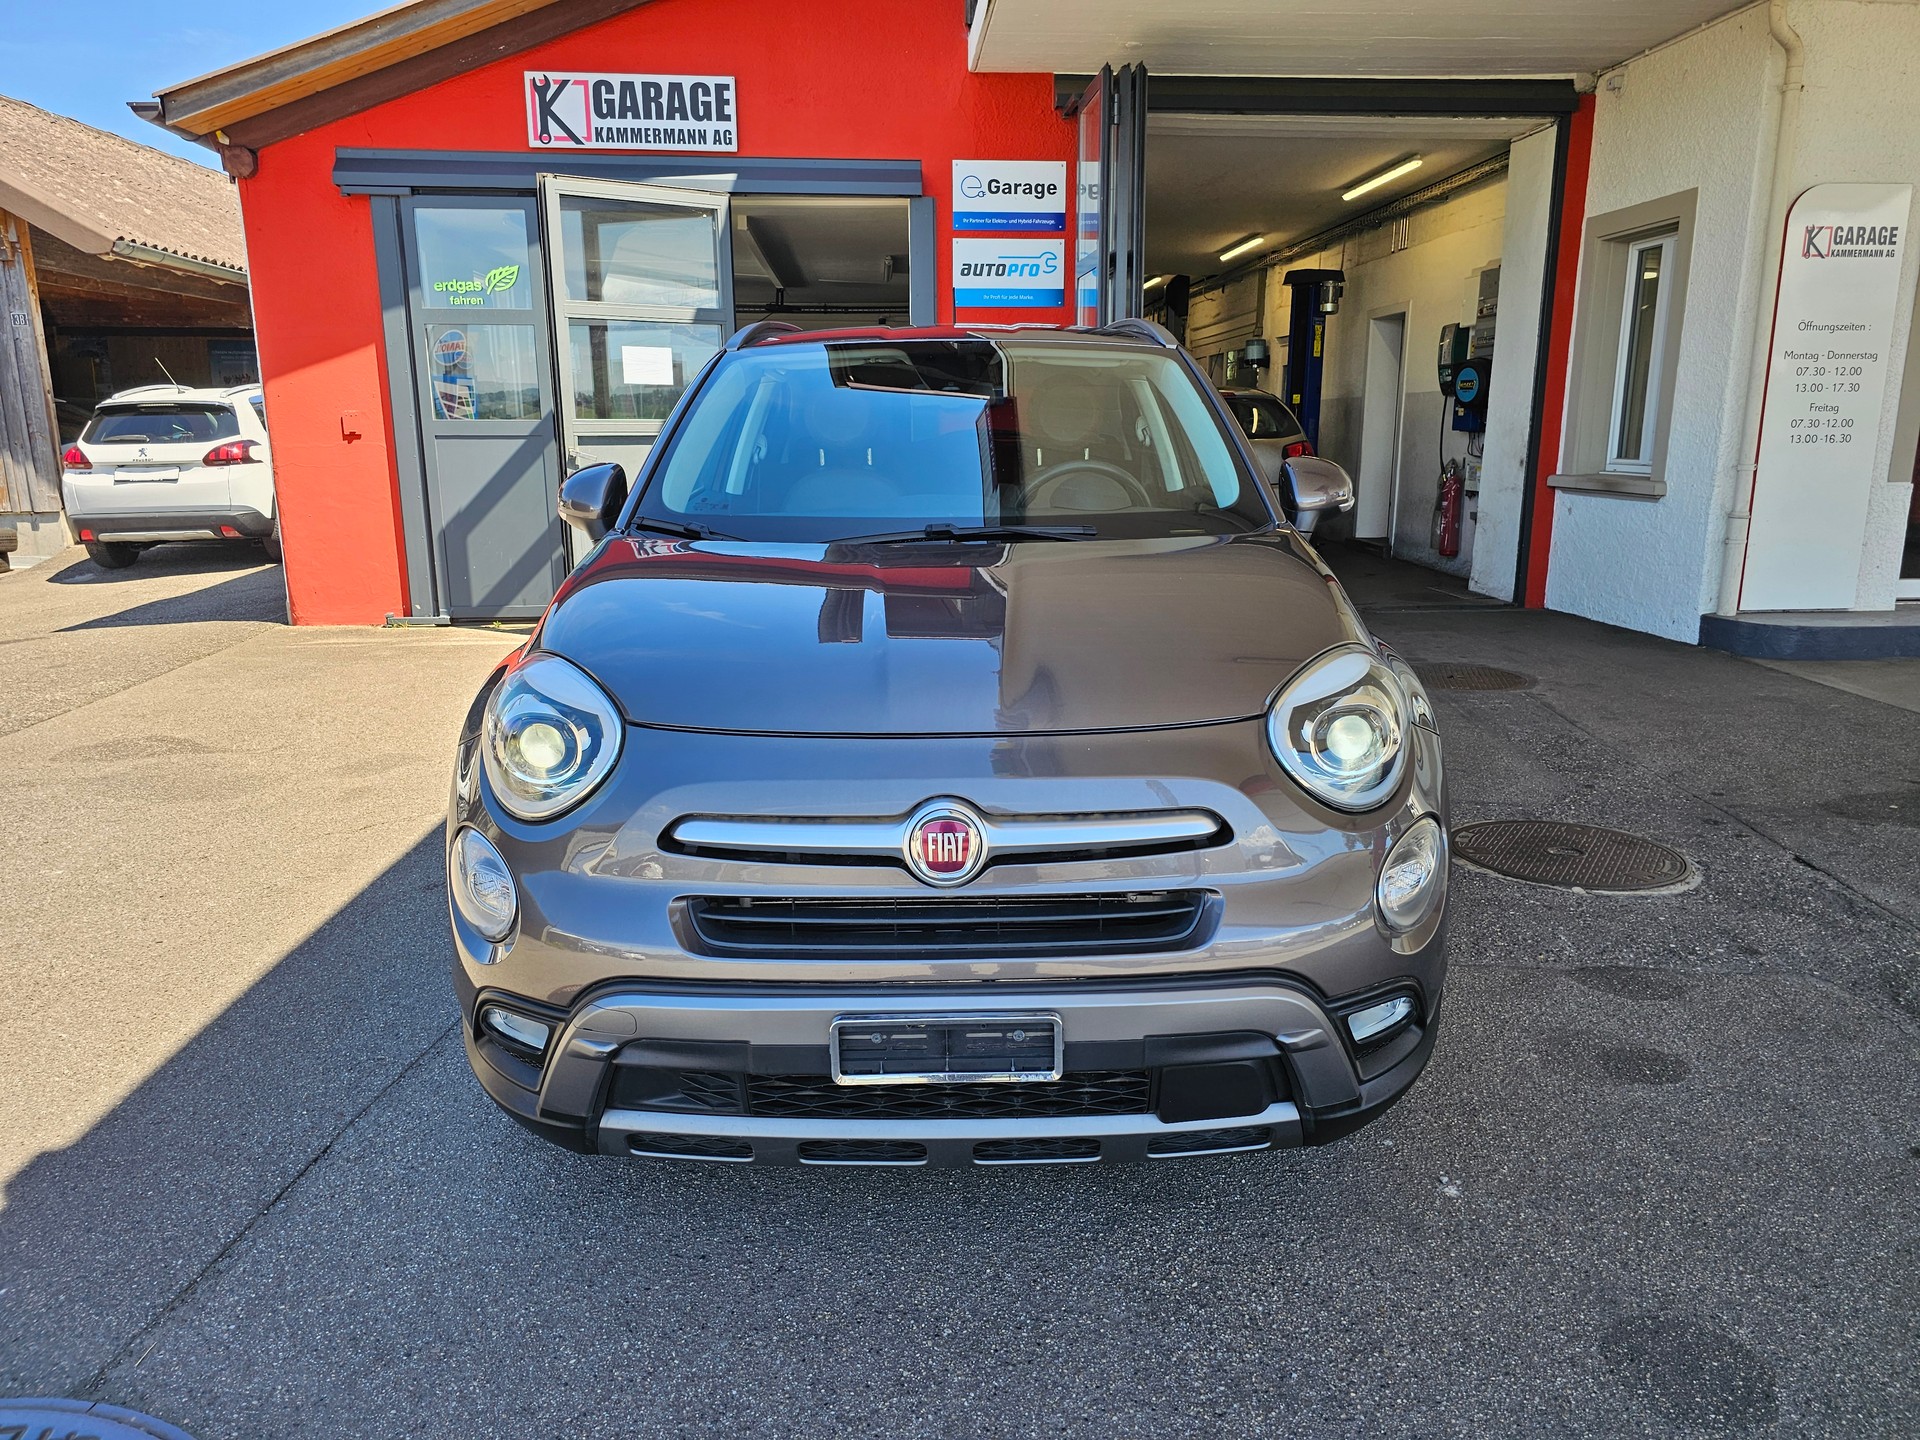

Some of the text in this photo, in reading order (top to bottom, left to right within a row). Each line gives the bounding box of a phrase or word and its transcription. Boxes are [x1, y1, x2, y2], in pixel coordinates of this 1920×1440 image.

[592, 79, 732, 122] GARAGE
[594, 126, 733, 146] KAMMERMANN AG
[987, 179, 1058, 199] Garage
[1833, 226, 1899, 246] GARAGE
[1830, 249, 1895, 258] KAMMERMANN AG
[433, 279, 483, 294] erdgas
[449, 295, 484, 305] fahren
[1798, 319, 1866, 334] Öffnungszeiten
[1783, 350, 1819, 362] Montag
[1827, 350, 1878, 362] Donnerstag
[1795, 366, 1826, 376] 07.30
[1834, 366, 1863, 376] 12.00
[1795, 383, 1824, 393] 13.00
[1832, 382, 1860, 392] 17.30
[1809, 402, 1840, 414] Freitag
[927, 832, 966, 862] FIAT
